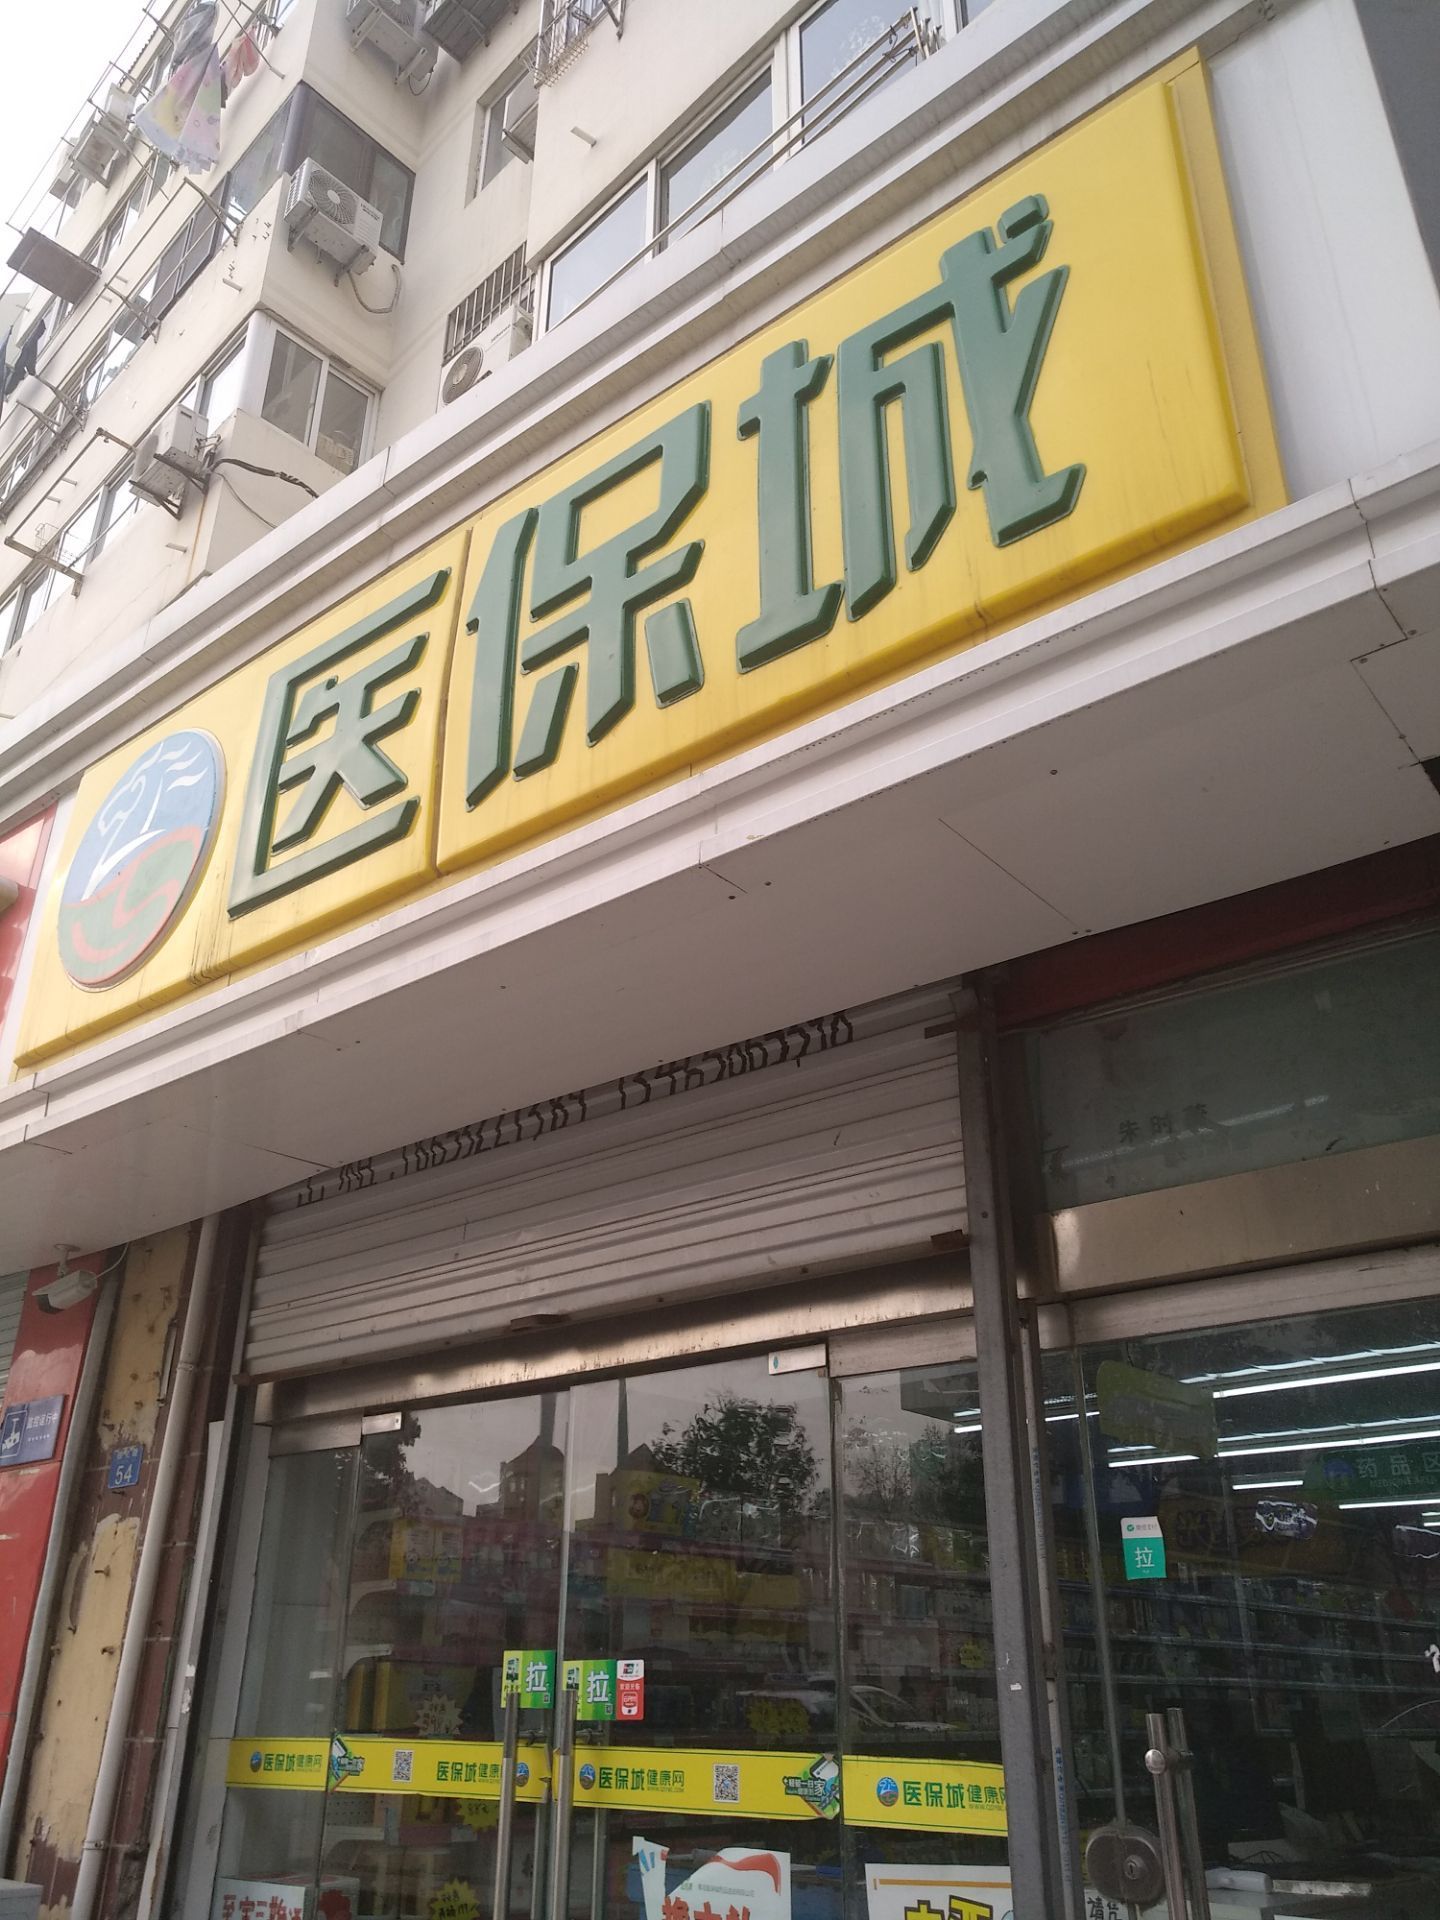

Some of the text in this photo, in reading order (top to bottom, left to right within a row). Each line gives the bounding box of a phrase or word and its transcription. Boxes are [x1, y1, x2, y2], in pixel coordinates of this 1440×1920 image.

[226, 194, 1085, 919] 医保城
[115, 1464, 132, 1485] 54
[1135, 1547, 1155, 1568] 拉
[526, 1661, 548, 1693] 拉
[587, 1670, 609, 1703] 拉
[263, 1752, 323, 1773] 医保城健康网
[437, 1761, 502, 1782] 医保城健康
[599, 1766, 685, 1791] 医保城健康网
